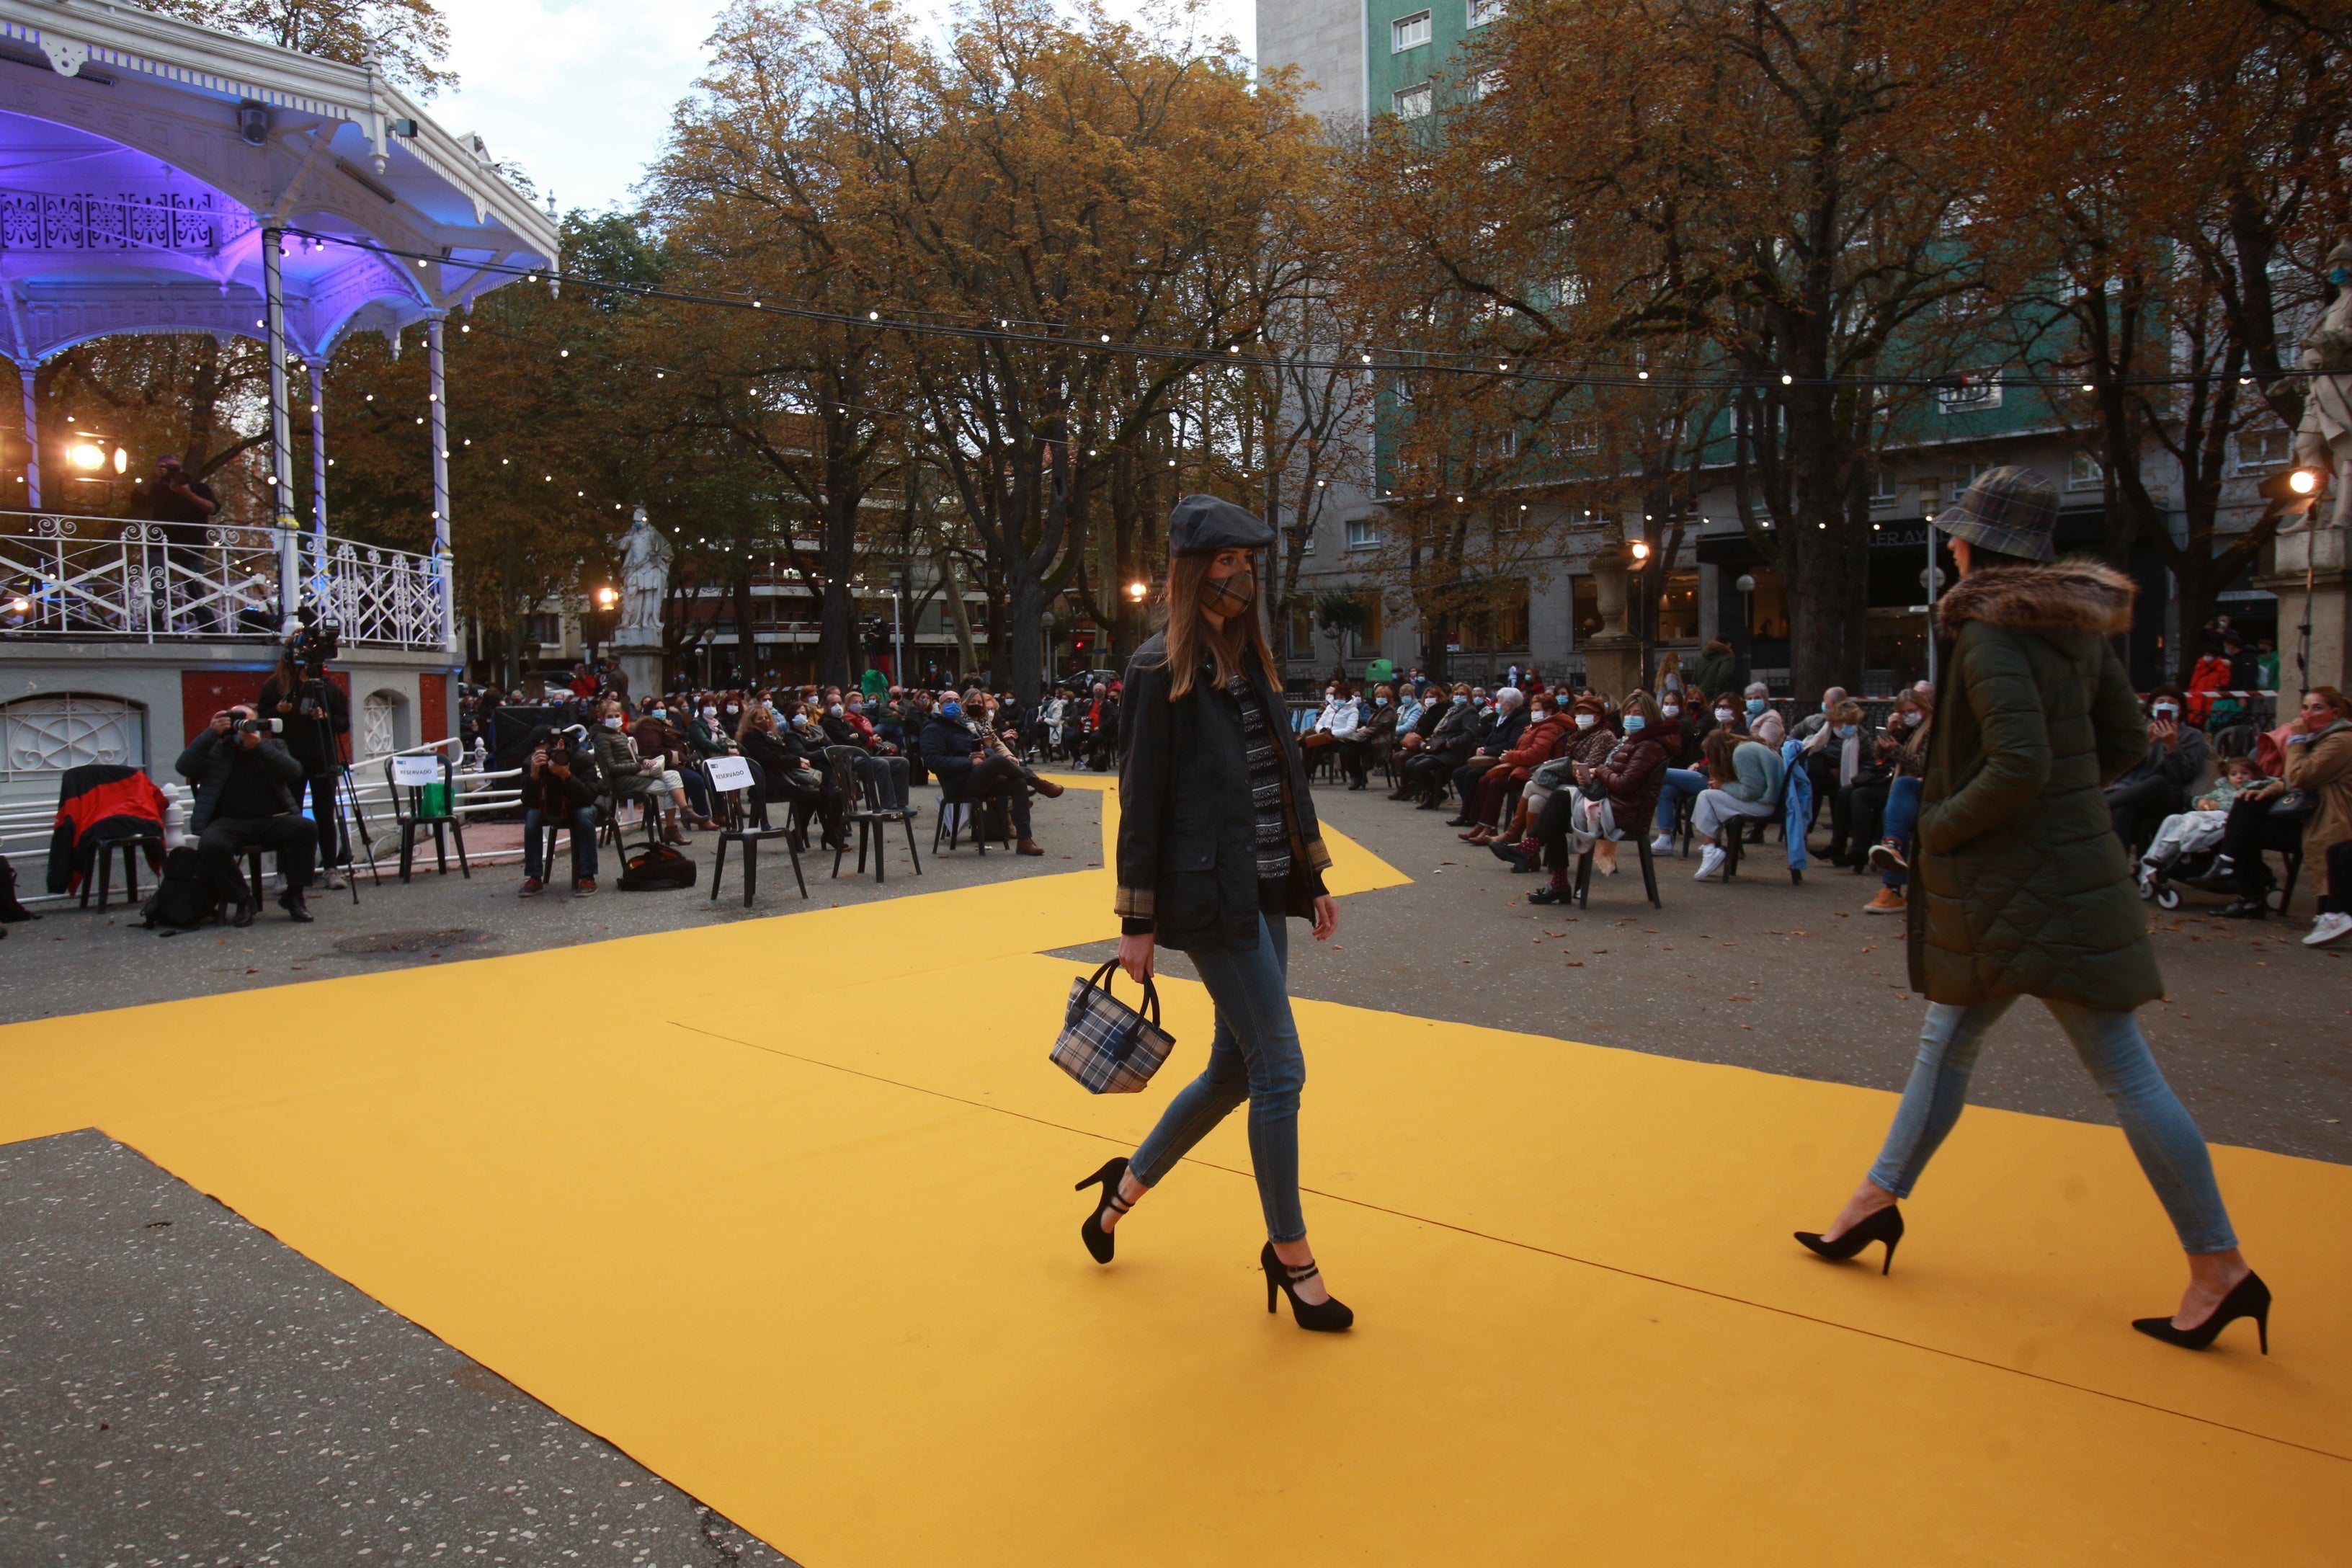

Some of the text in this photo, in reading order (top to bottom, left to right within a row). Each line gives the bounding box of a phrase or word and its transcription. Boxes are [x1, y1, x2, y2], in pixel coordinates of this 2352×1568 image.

[1867, 530, 1949, 545] LER AYL
[716, 770, 744, 779] RESERVADO
